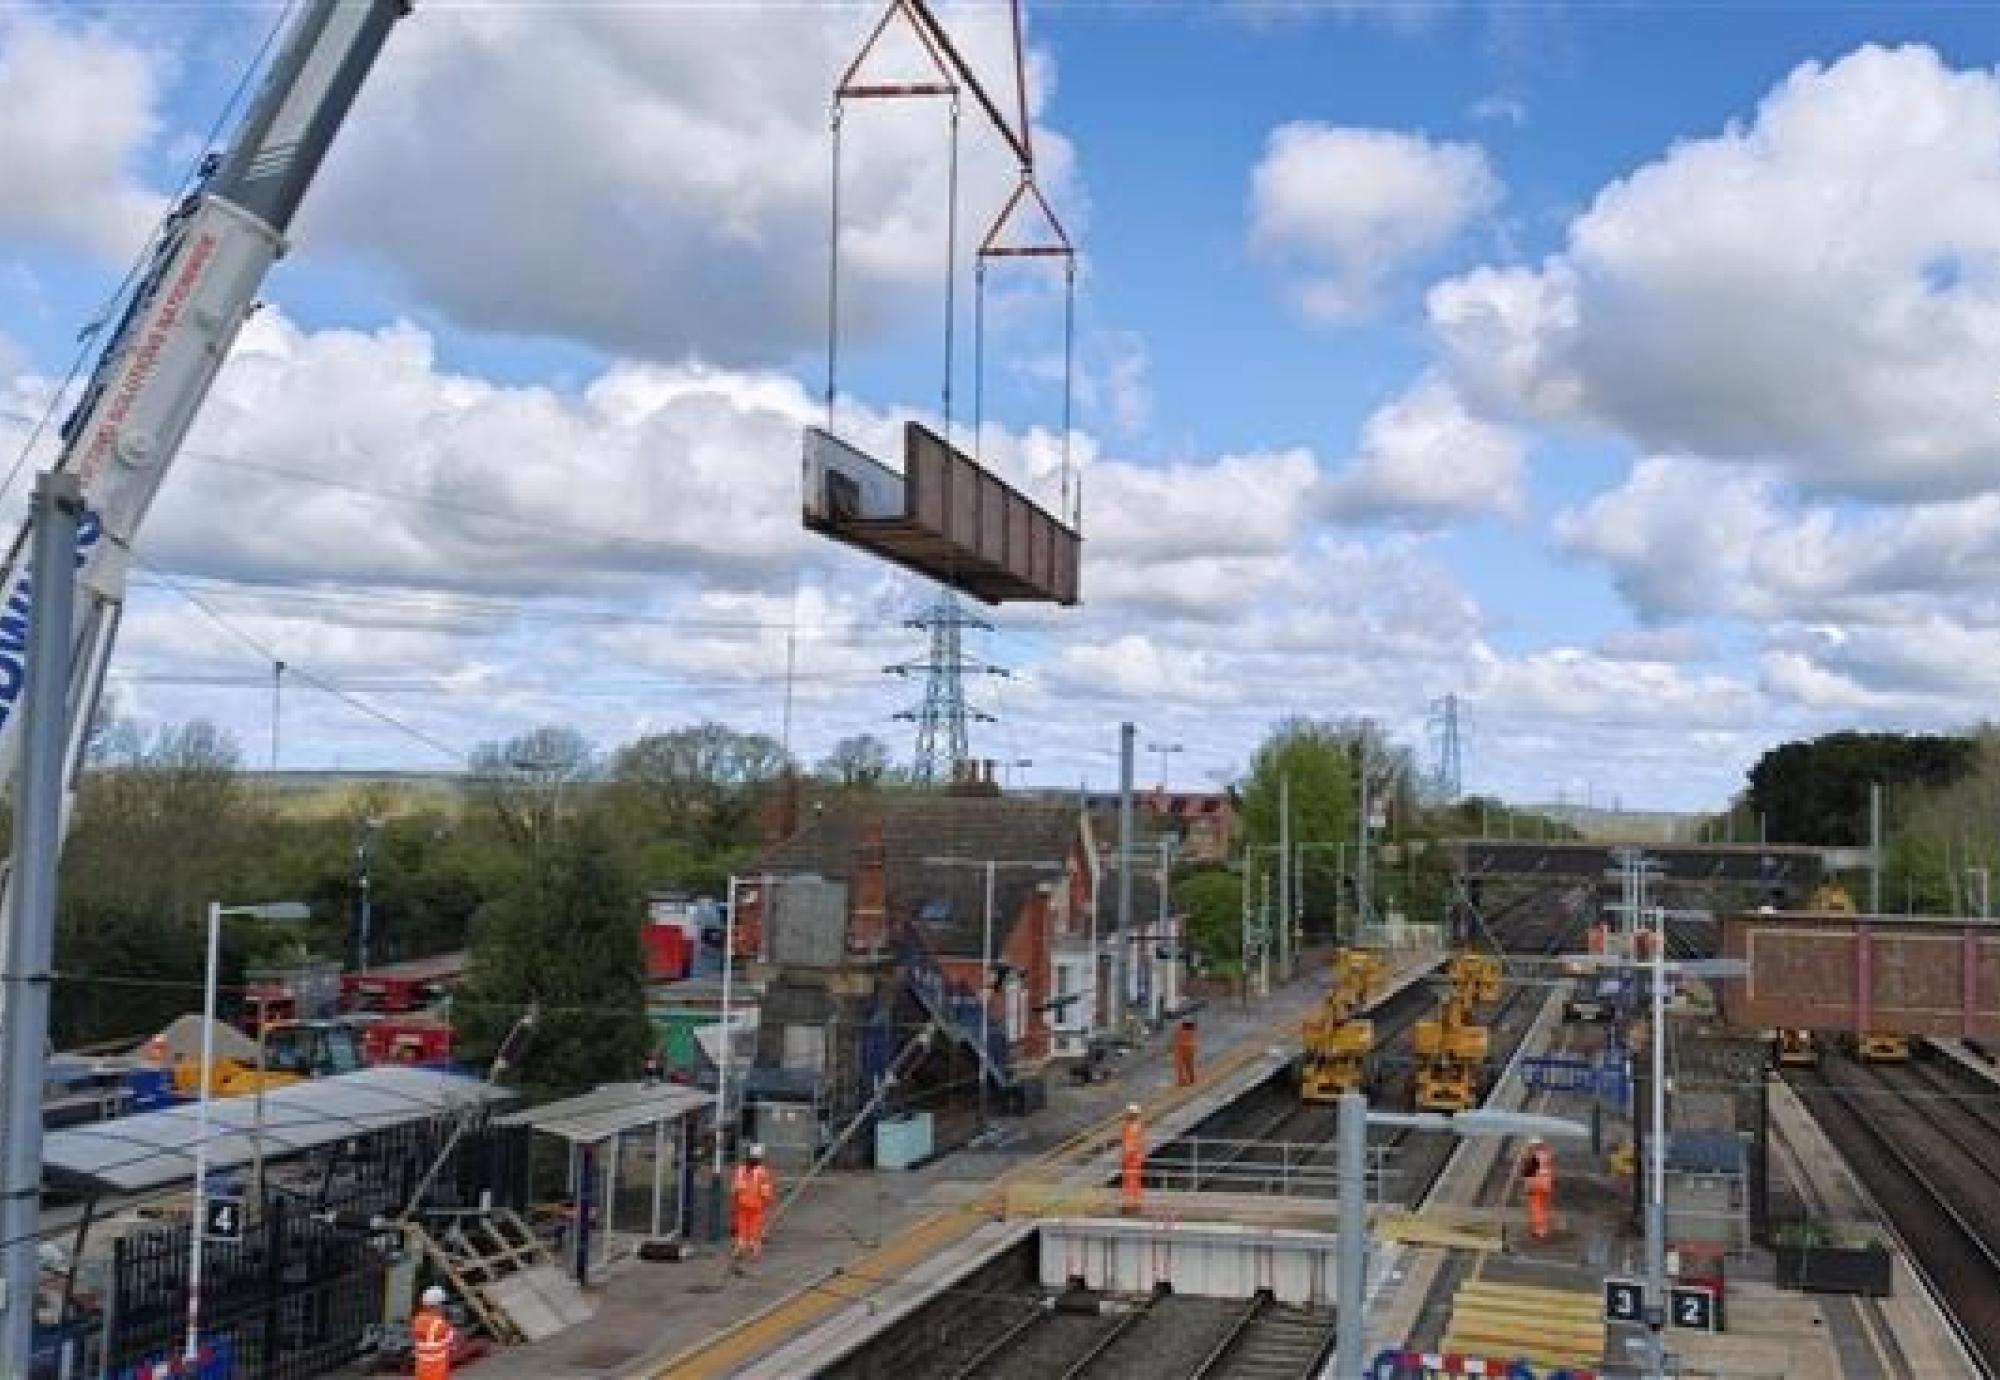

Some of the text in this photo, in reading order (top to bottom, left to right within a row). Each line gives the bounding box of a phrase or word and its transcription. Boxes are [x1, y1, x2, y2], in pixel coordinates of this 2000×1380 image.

[215, 1206, 232, 1232] 4
[1616, 1289, 1632, 1315] 3
[1682, 1297, 1699, 1323] 2
